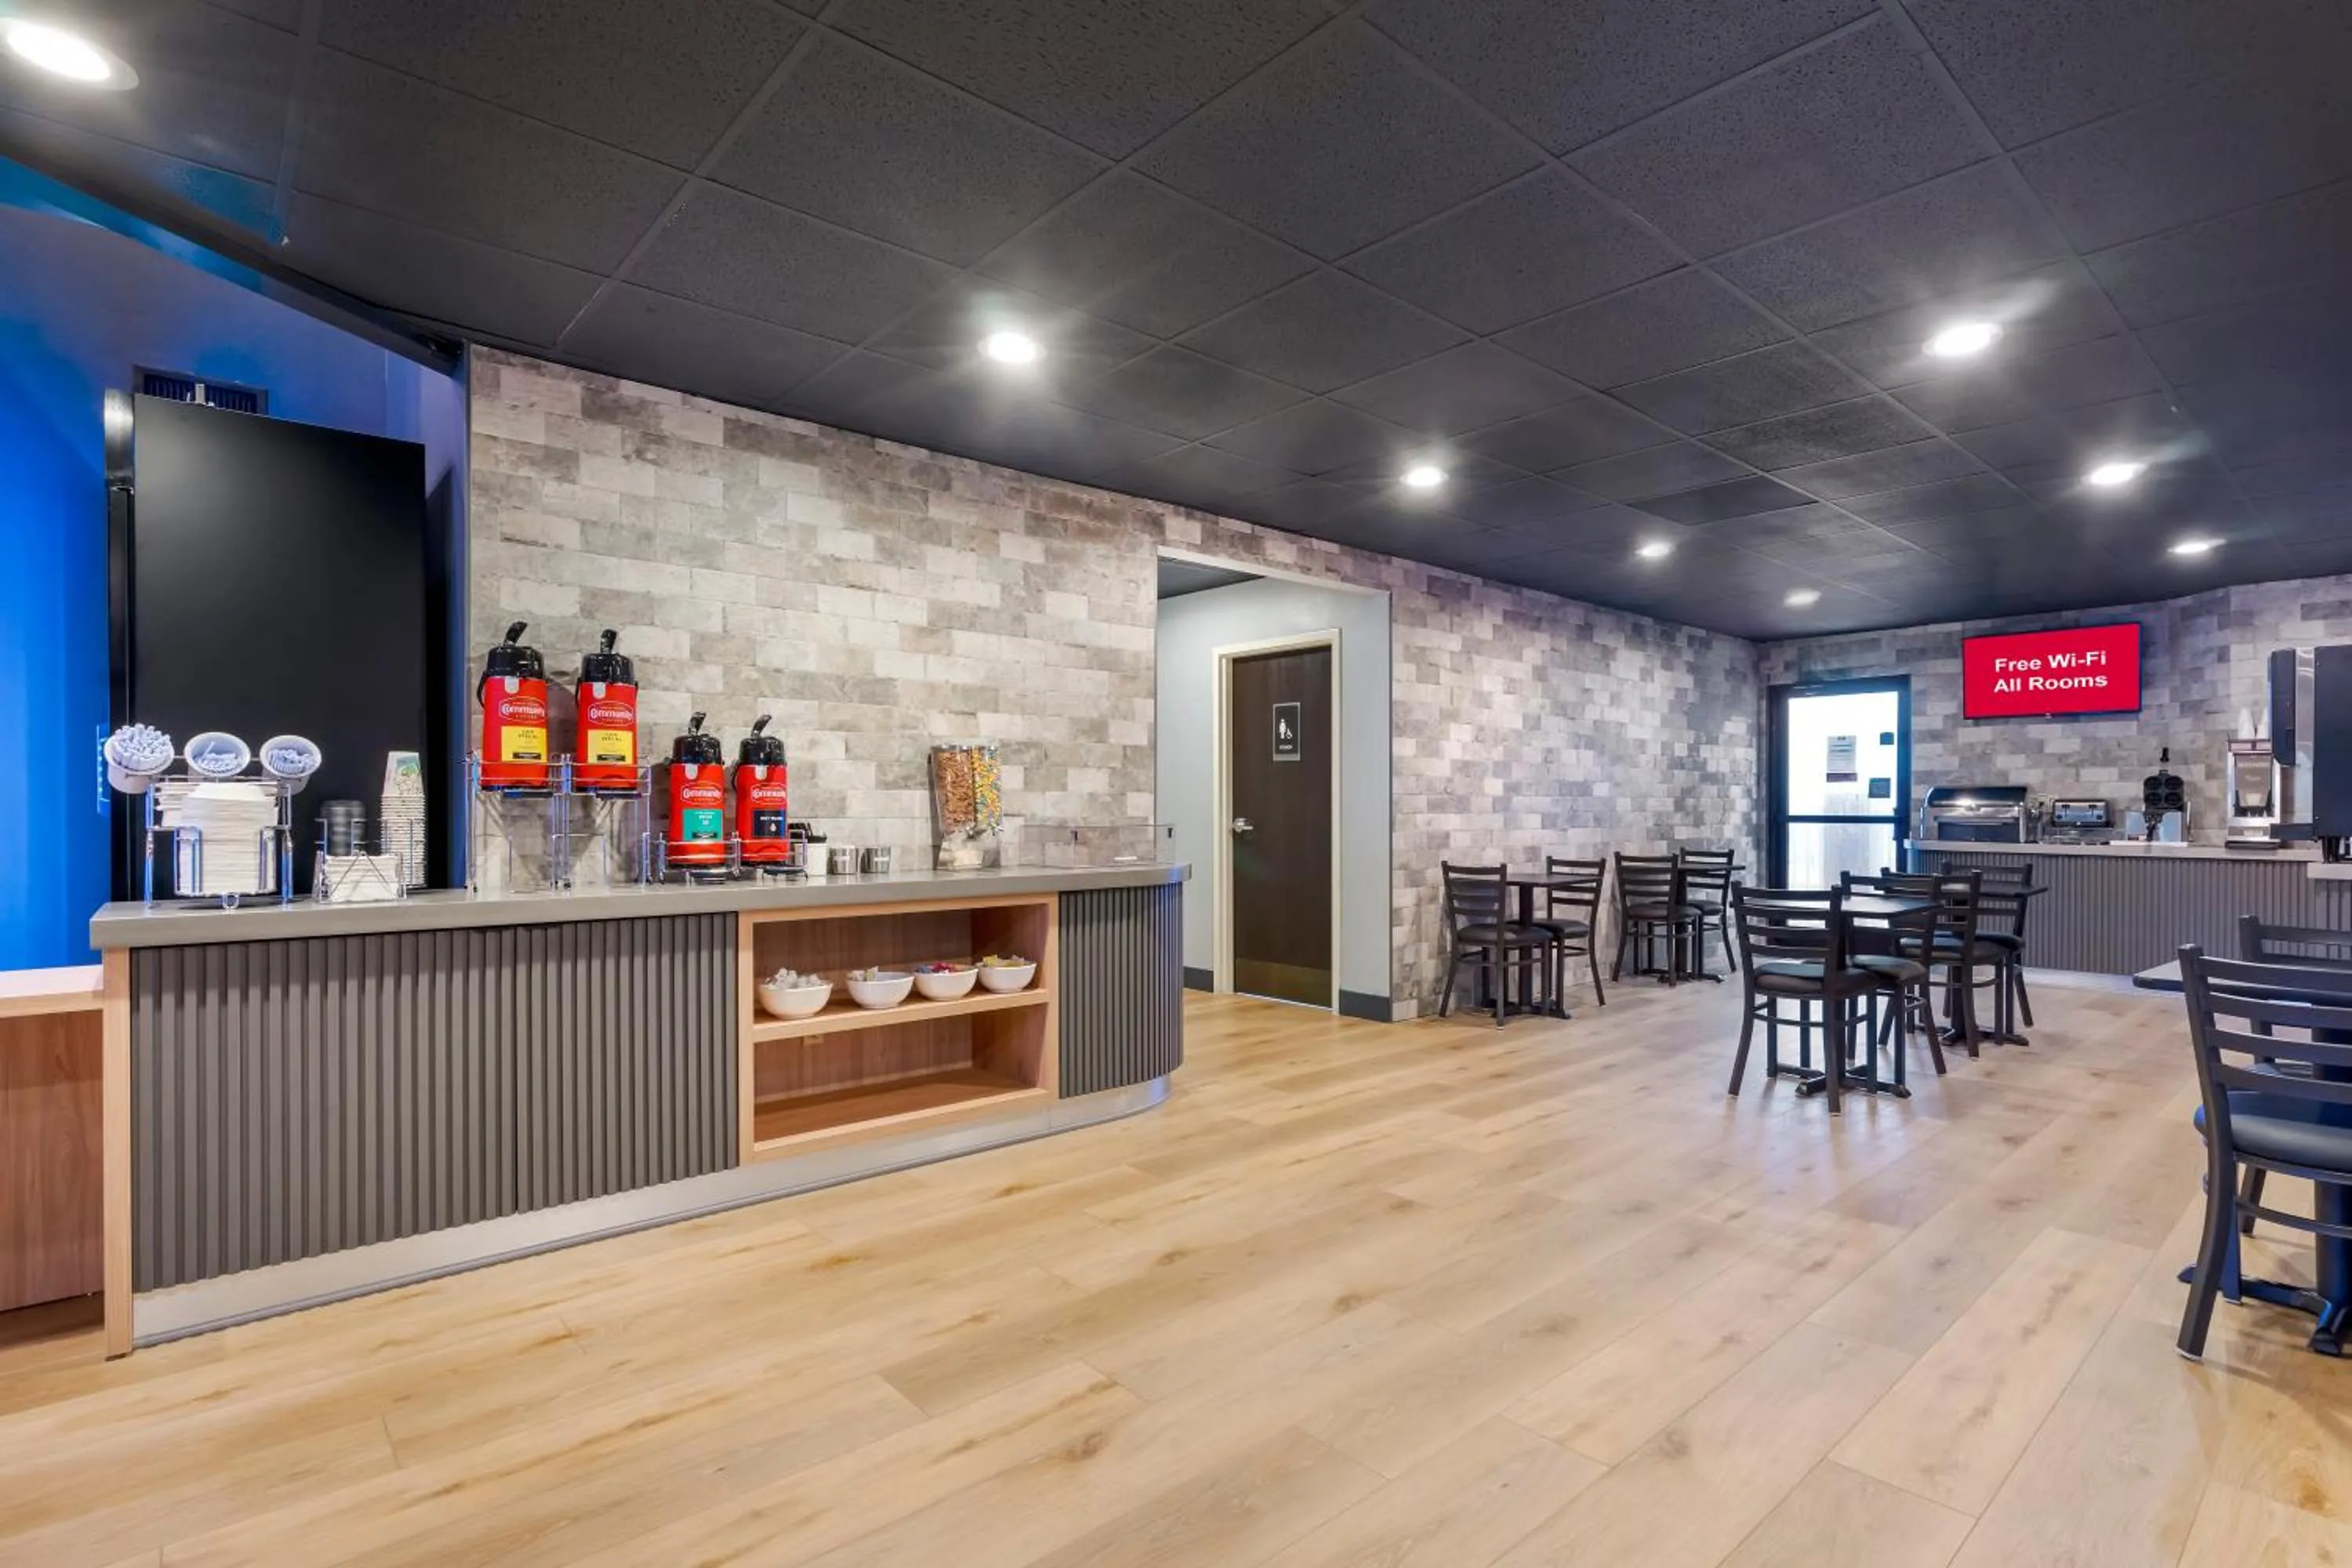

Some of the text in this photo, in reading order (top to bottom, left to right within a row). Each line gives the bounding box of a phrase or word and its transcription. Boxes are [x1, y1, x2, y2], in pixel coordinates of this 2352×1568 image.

[1994, 650, 2107, 673] Free Wi-Fi
[1994, 675, 2108, 693] All Rooms
